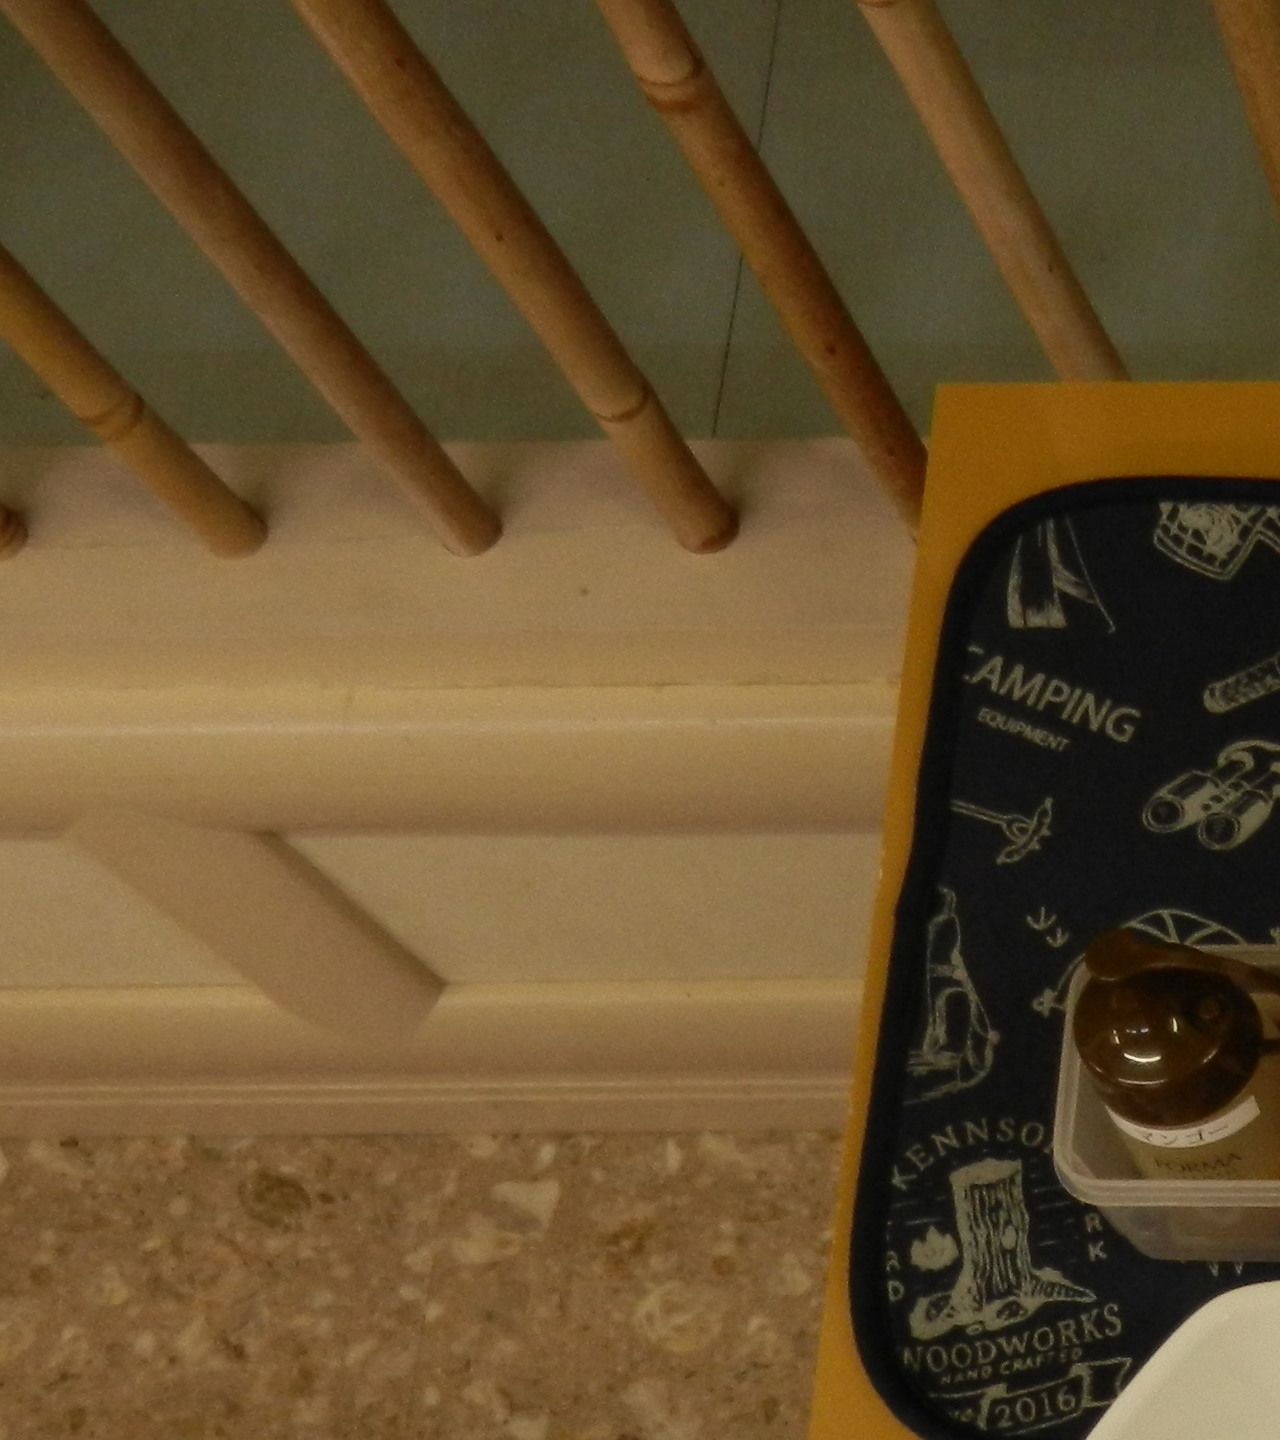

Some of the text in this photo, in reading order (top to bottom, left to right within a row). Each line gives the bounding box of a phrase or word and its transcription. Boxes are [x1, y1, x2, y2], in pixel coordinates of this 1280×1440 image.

[977, 707, 1072, 752] EQUIPMENT
[889, 1117, 1054, 1192] KENNSO
[940, 1347, 1084, 1386] HAND CRAFTED
[995, 1385, 1077, 1428] 2016
